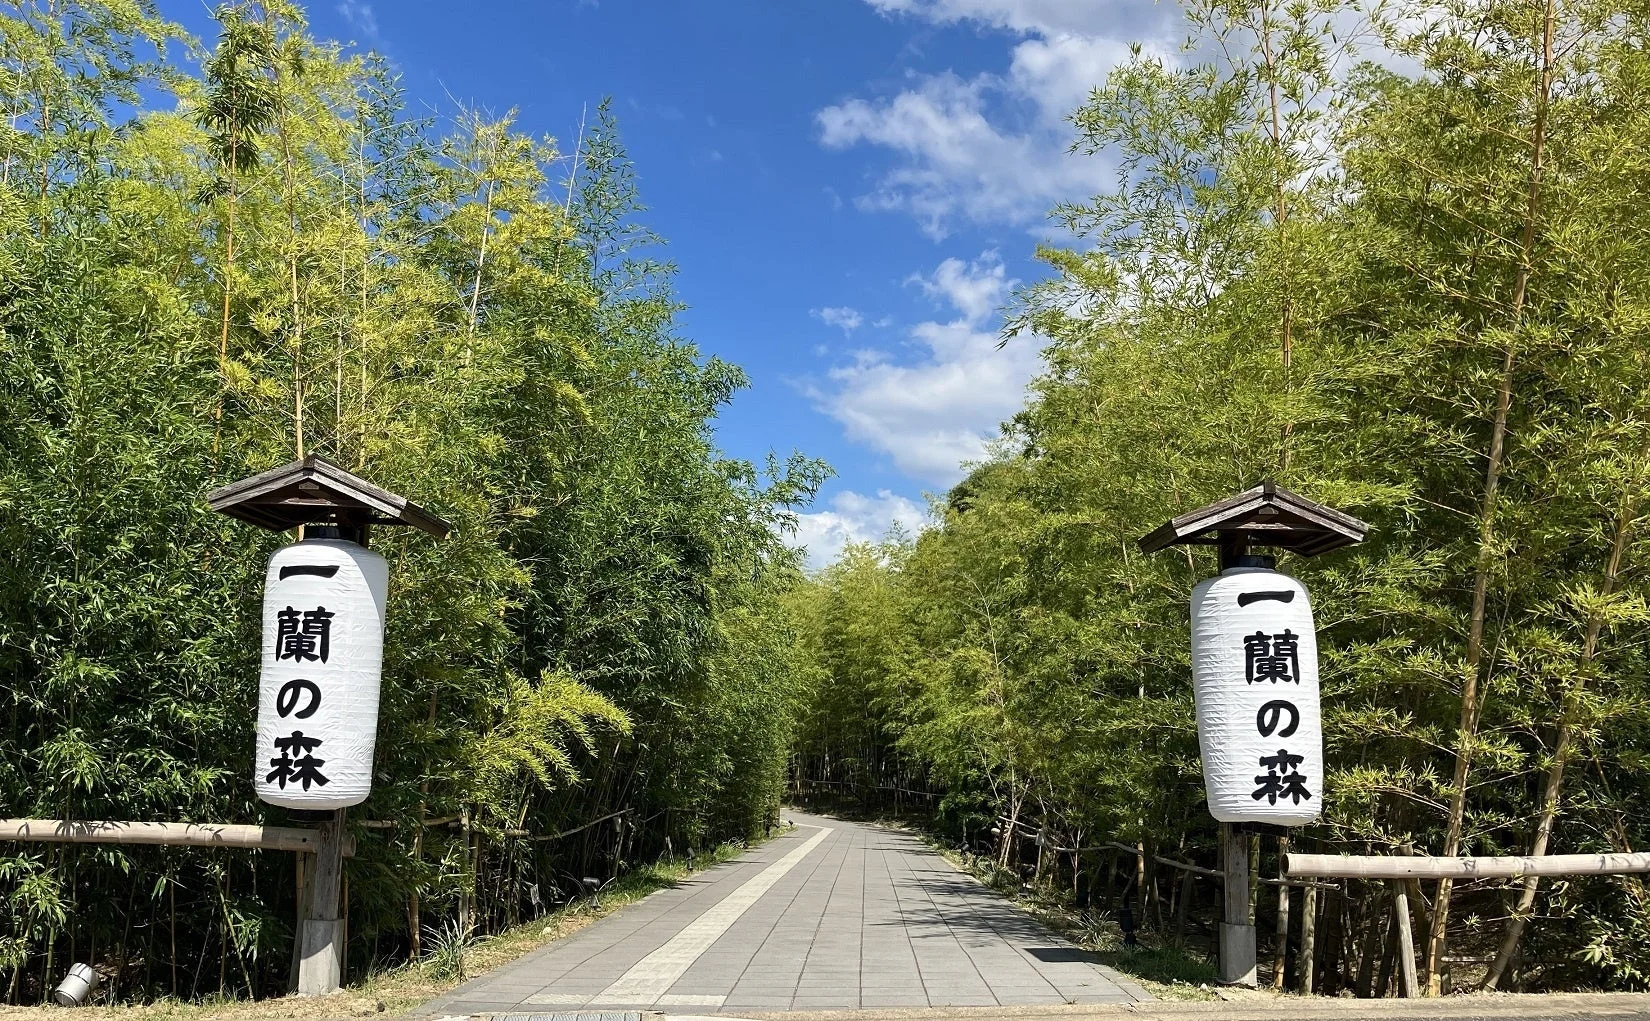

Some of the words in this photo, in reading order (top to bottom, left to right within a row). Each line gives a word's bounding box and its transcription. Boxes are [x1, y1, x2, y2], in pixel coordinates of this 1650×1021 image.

[265, 564, 340, 792] 一蘭の森
[1237, 590, 1312, 806] 一蘭の森
